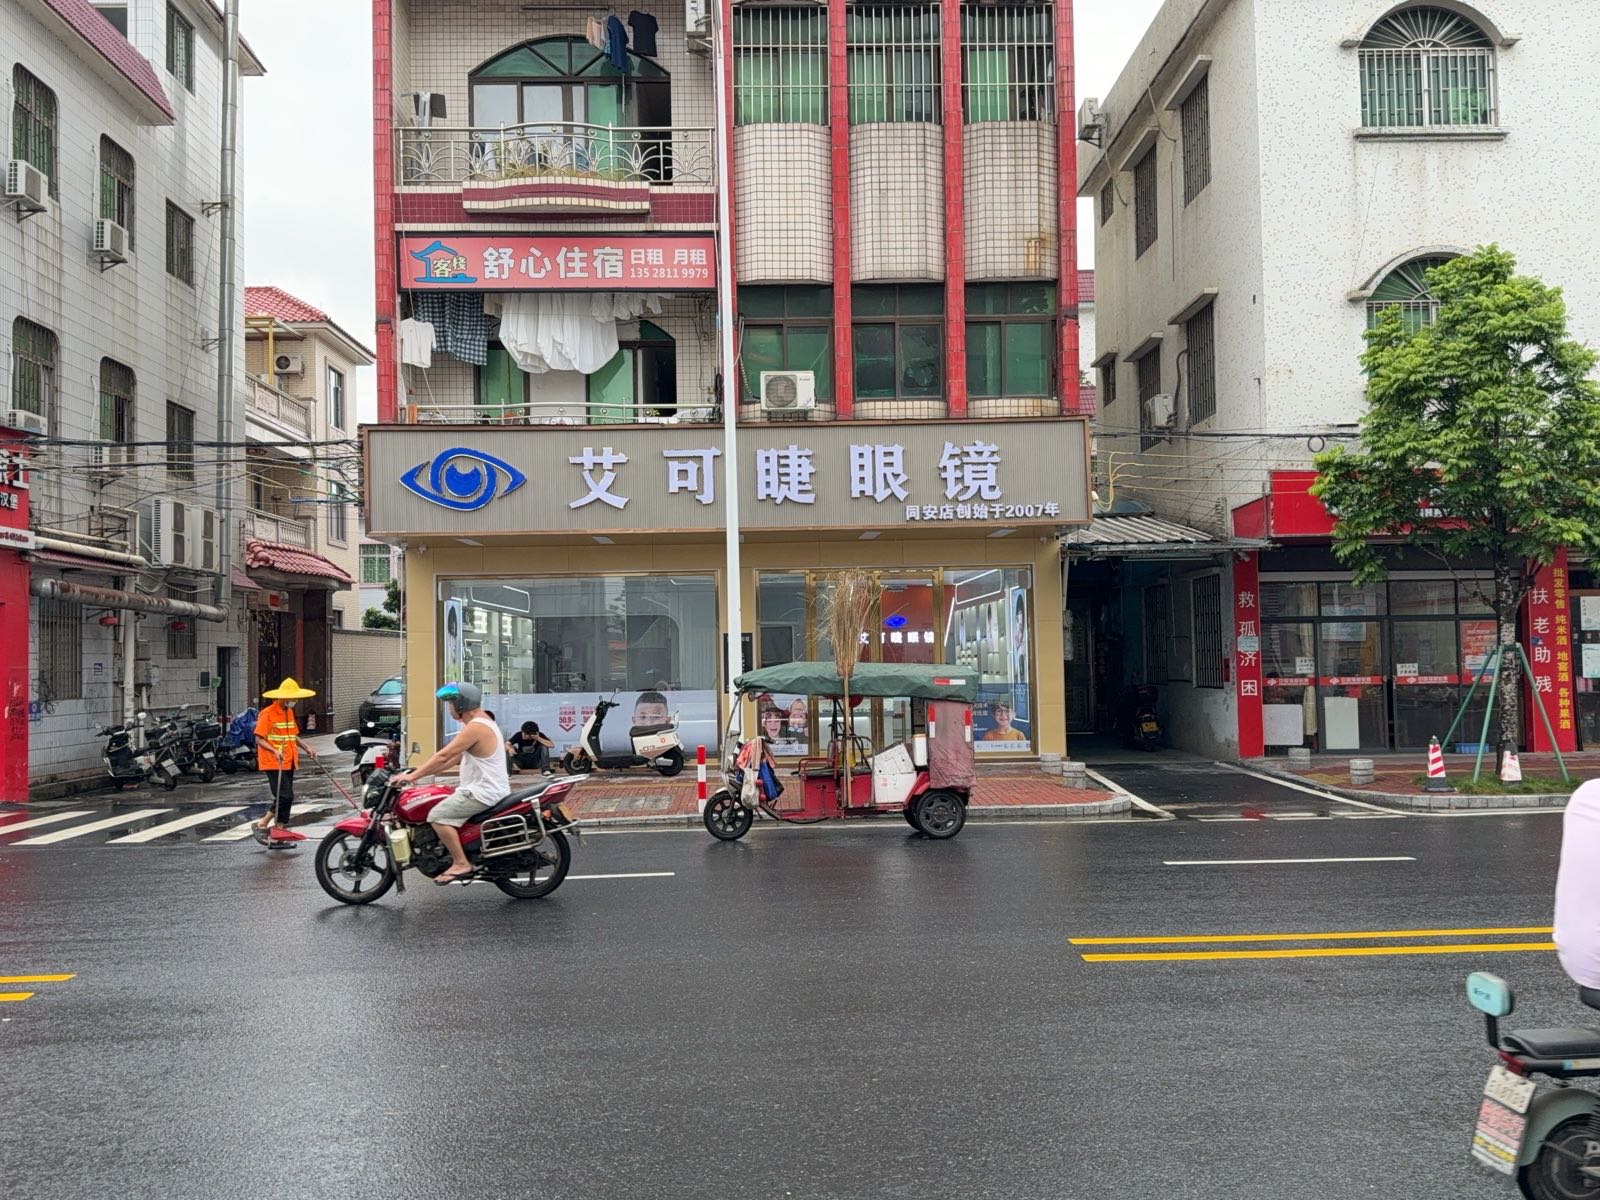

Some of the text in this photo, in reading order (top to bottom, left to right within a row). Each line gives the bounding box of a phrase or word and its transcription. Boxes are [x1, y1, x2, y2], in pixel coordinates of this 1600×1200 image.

[432, 255, 467, 278] 客栈
[482, 246, 624, 279] 舒心住宿
[630, 249, 707, 265] 日租 月租
[630, 267, 709, 279] 135 2811 9979
[568, 440, 1003, 510] 艾可睫眼镜
[905, 501, 1061, 521] 同安店创始于2007年
[1552, 567, 1566, 609] 批发零售
[1238, 591, 1258, 697] 救孤济困
[1532, 587, 1552, 693] 扶老助残
[1555, 615, 1568, 646] 纯米酒
[1558, 687, 1571, 729] 各种果酒
